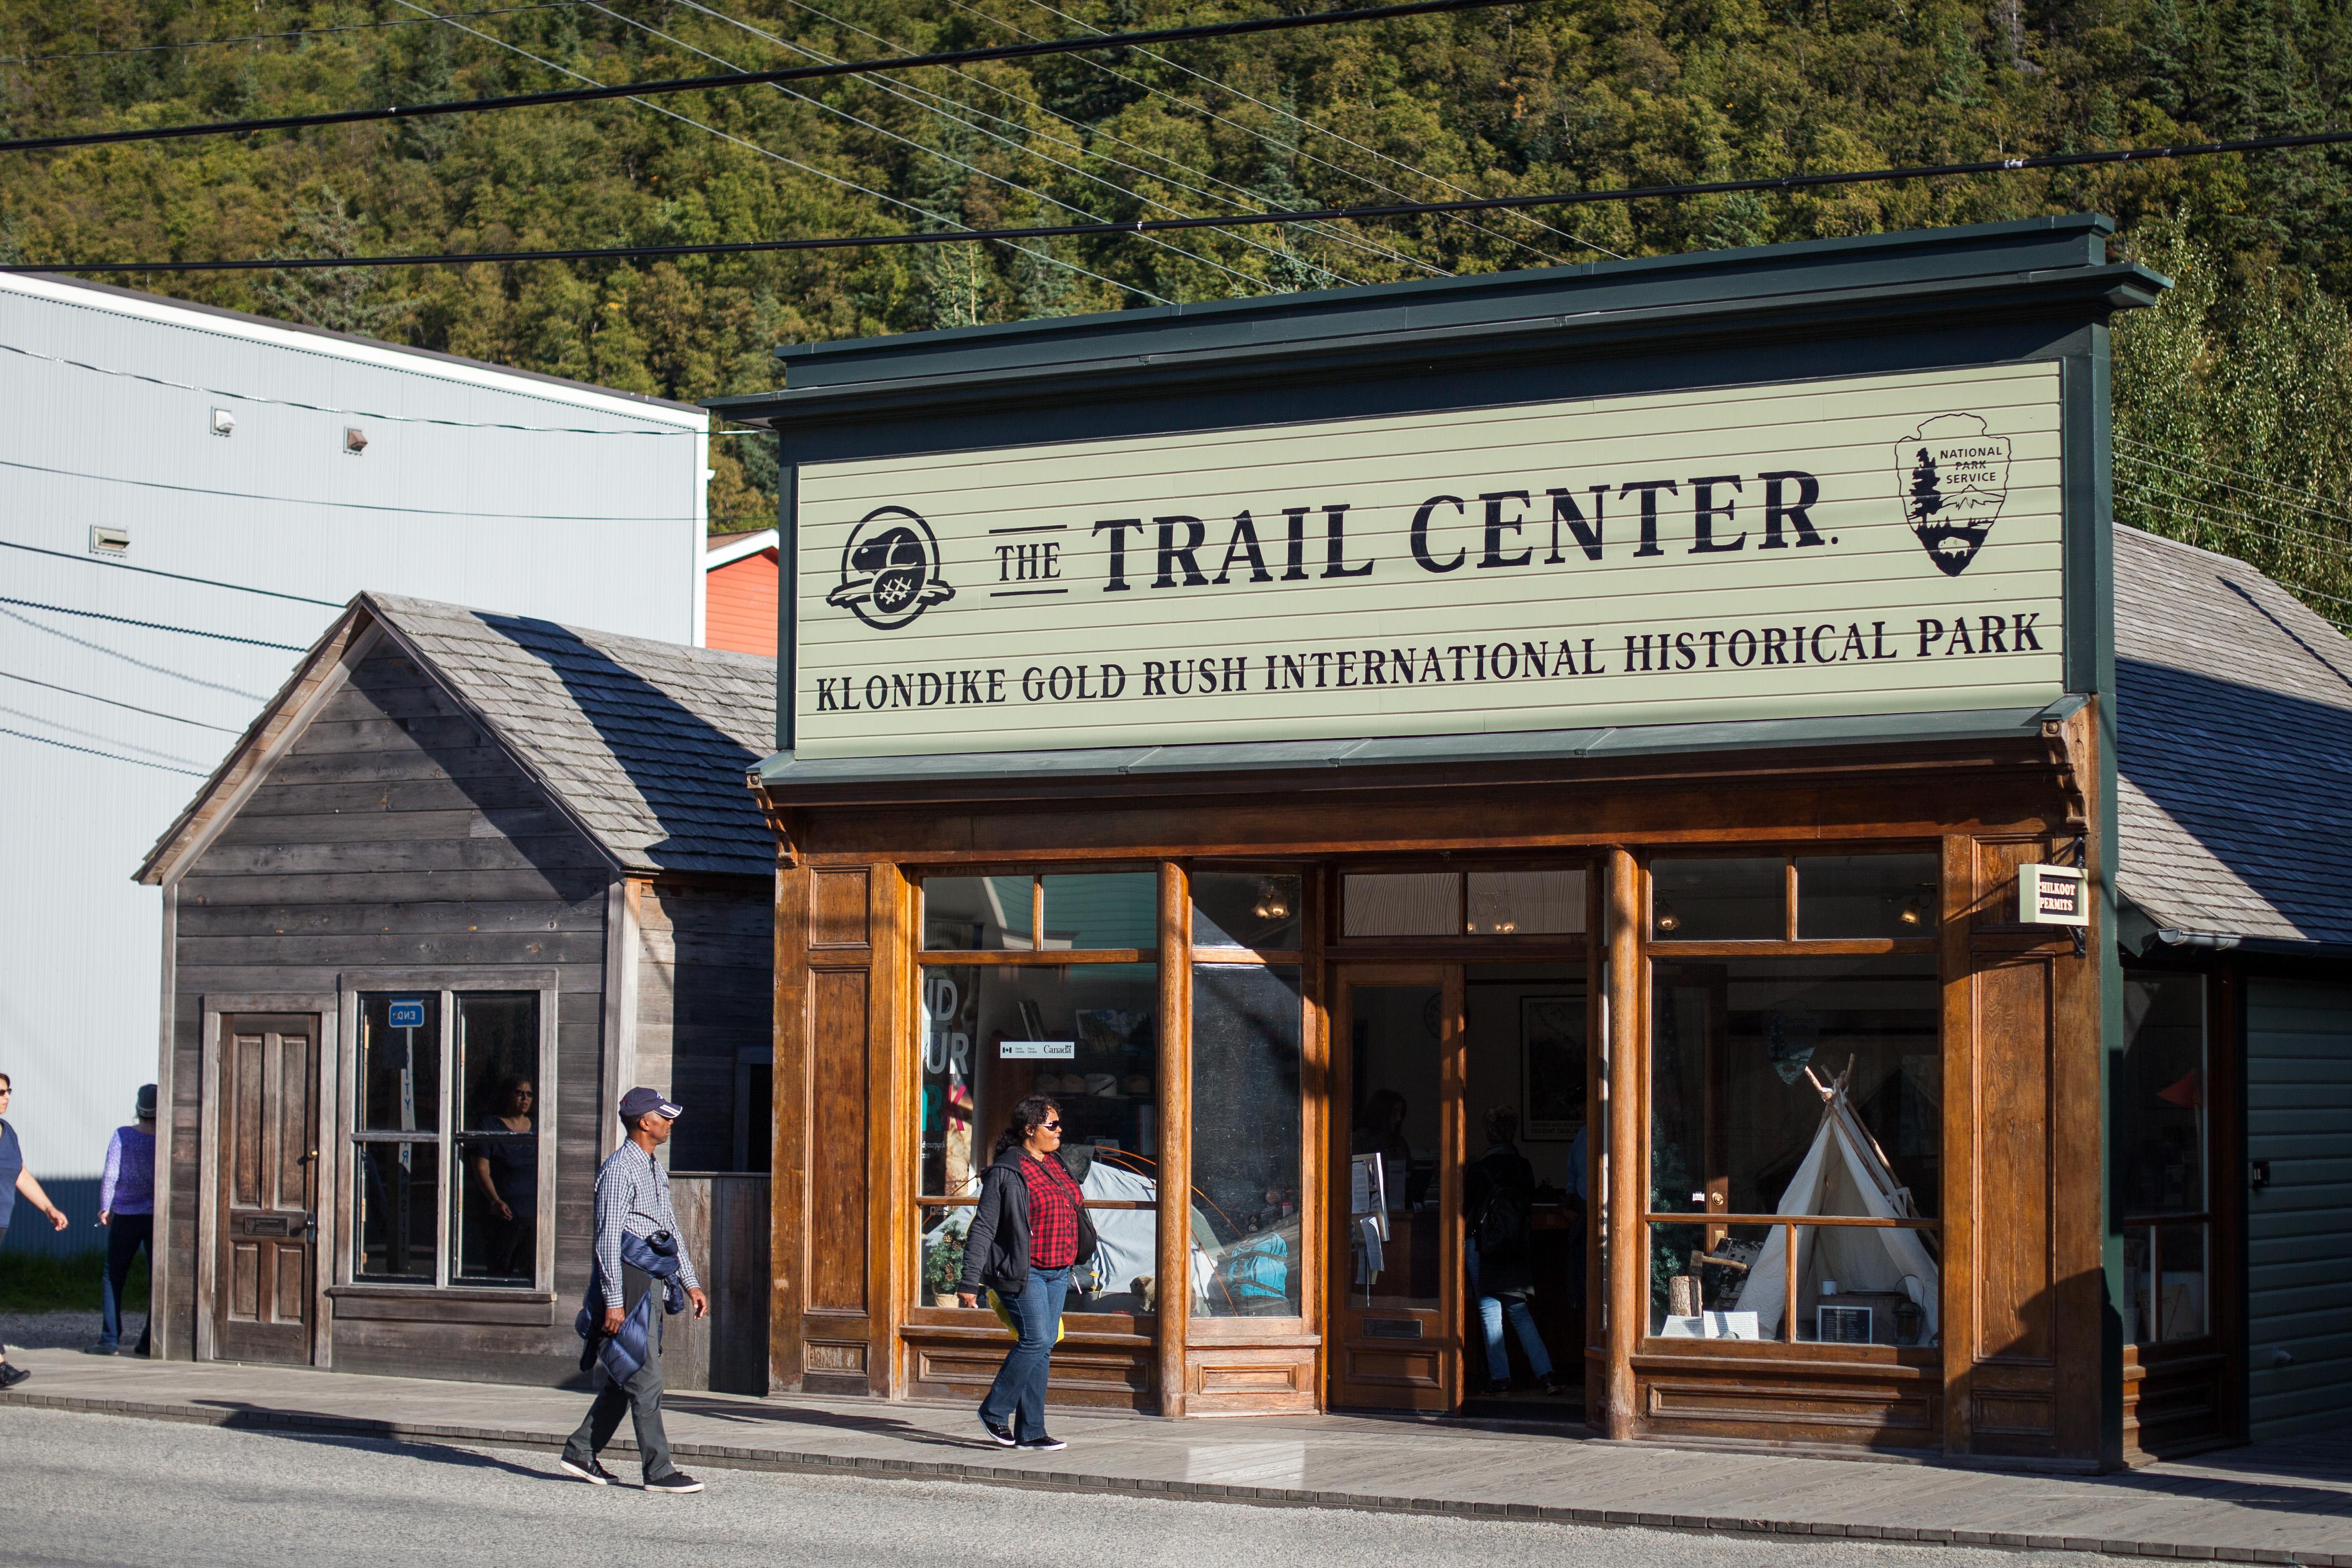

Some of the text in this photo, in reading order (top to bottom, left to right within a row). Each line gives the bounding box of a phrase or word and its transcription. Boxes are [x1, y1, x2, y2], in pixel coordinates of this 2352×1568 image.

[1940, 446, 2002, 460] NATIONAL
[1955, 460, 1987, 471] PARK
[1946, 472, 1996, 484] SERVICE
[995, 471, 1838, 592] THE TRAIL CENTER.
[816, 613, 2043, 711] KLONDIKE GOLD RUSH INTERNATIONAL HISTORICAL PARK
[2039, 897, 2073, 911] PERMITS
[1043, 1044, 1072, 1054] Canada
